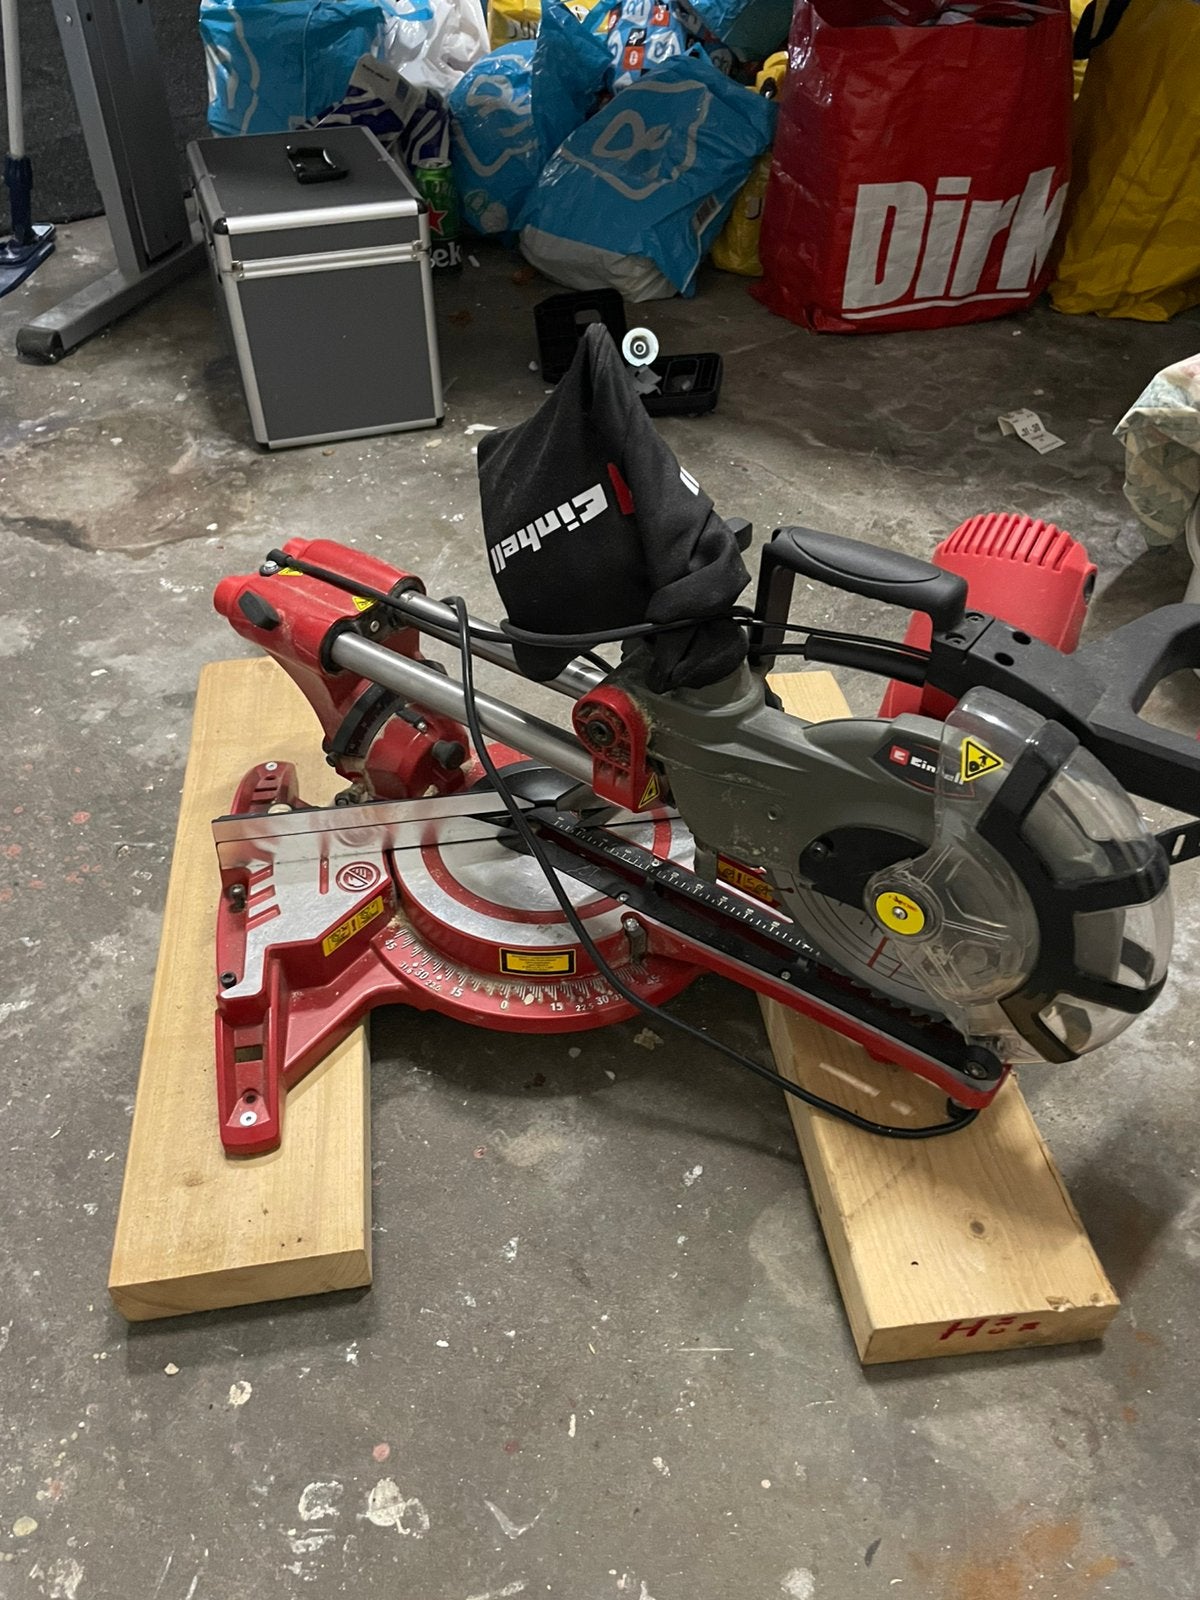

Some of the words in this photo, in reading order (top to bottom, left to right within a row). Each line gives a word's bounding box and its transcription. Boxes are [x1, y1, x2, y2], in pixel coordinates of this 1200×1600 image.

[842, 166, 1068, 309] Dirk
[490, 483, 608, 574] Einhell
[414, 968, 429, 979] 30
[450, 986, 463, 997] 15
[500, 1000, 508, 1009] 0
[551, 1002, 563, 1011] 15
[595, 995, 609, 1005] 30
